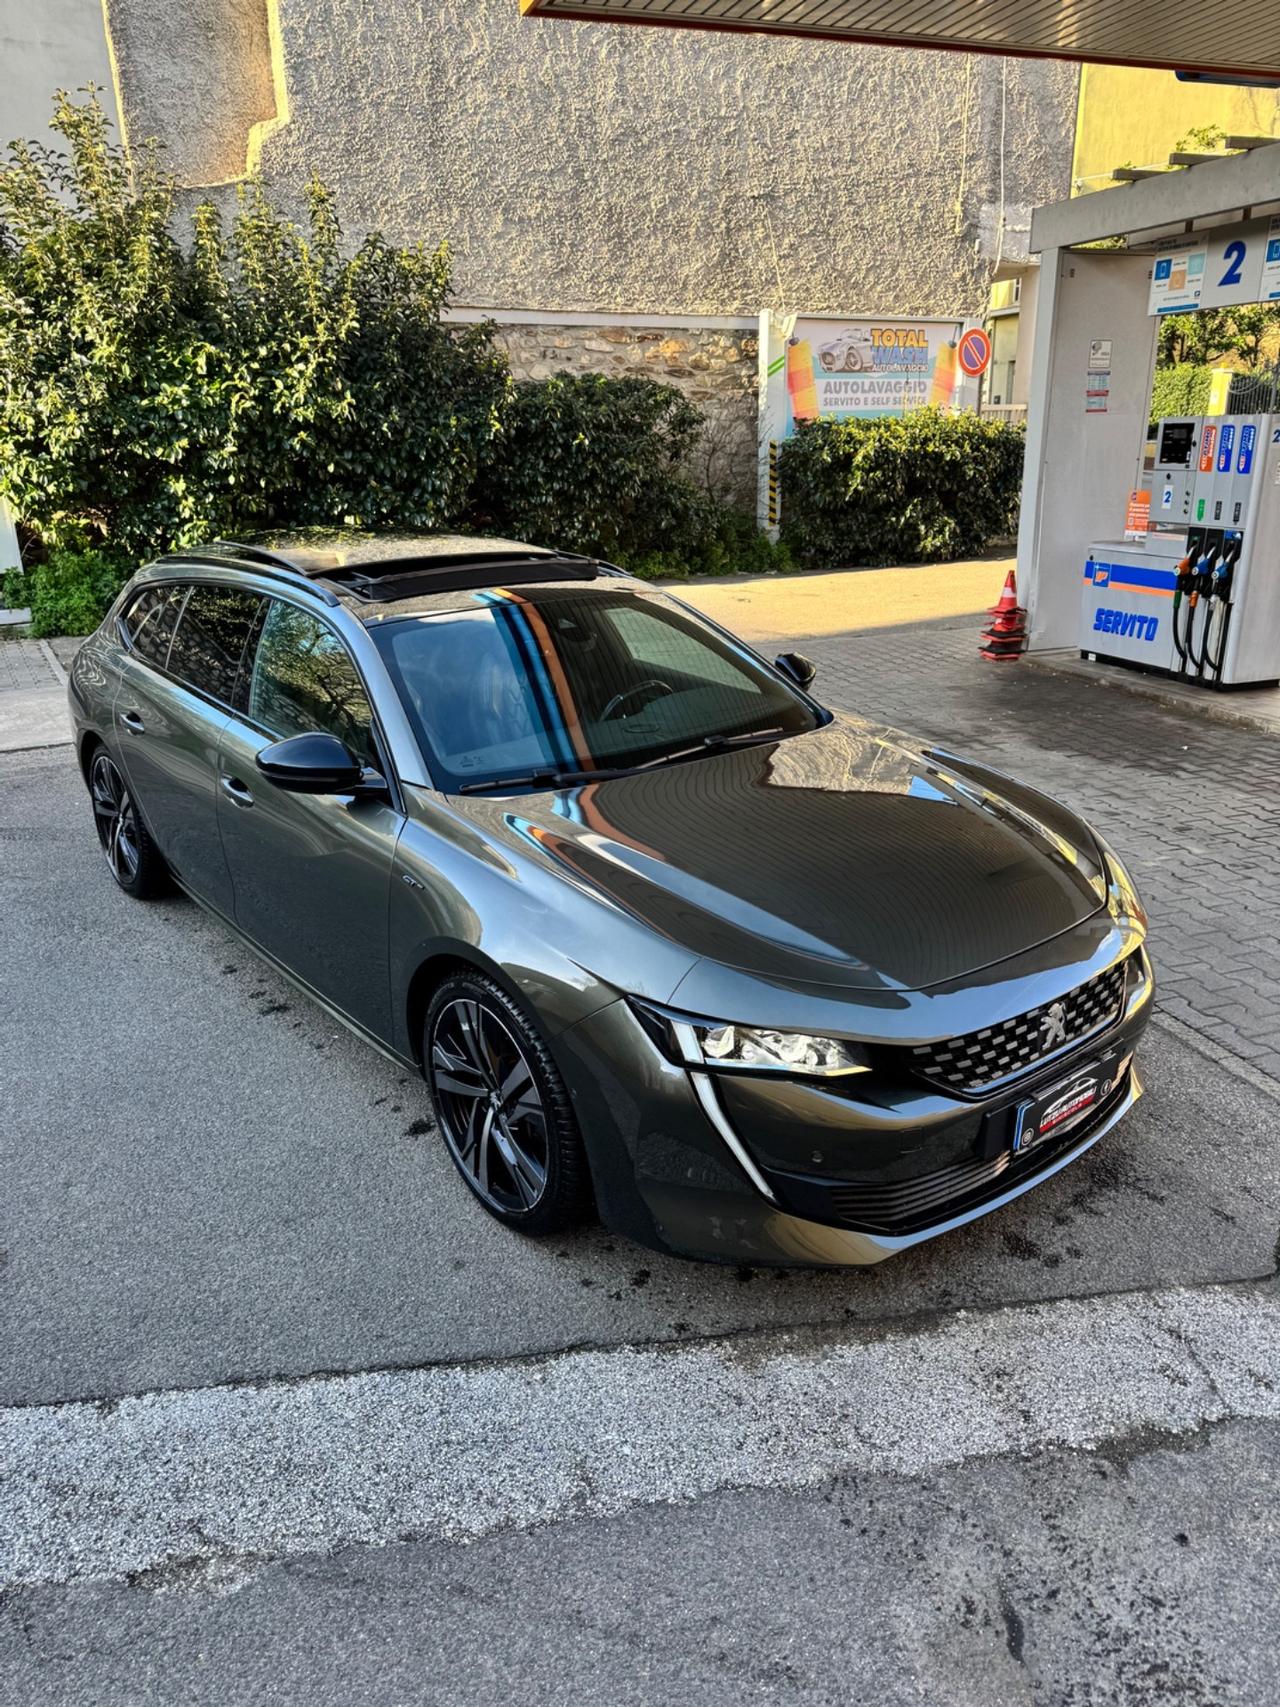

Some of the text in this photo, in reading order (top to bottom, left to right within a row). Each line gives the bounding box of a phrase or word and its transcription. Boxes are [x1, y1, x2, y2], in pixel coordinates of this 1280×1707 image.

[1217, 240, 1247, 287] 2
[870, 328, 928, 347] TOTAL
[871, 346, 928, 364] WASH
[824, 381, 927, 394] AUTOLAVAGGIO
[823, 397, 861, 406] SERVITO
[863, 397, 869, 405] E
[870, 397, 891, 405] SELF
[1164, 491, 1171, 503] 2
[1093, 608, 1158, 641] SERVITO
